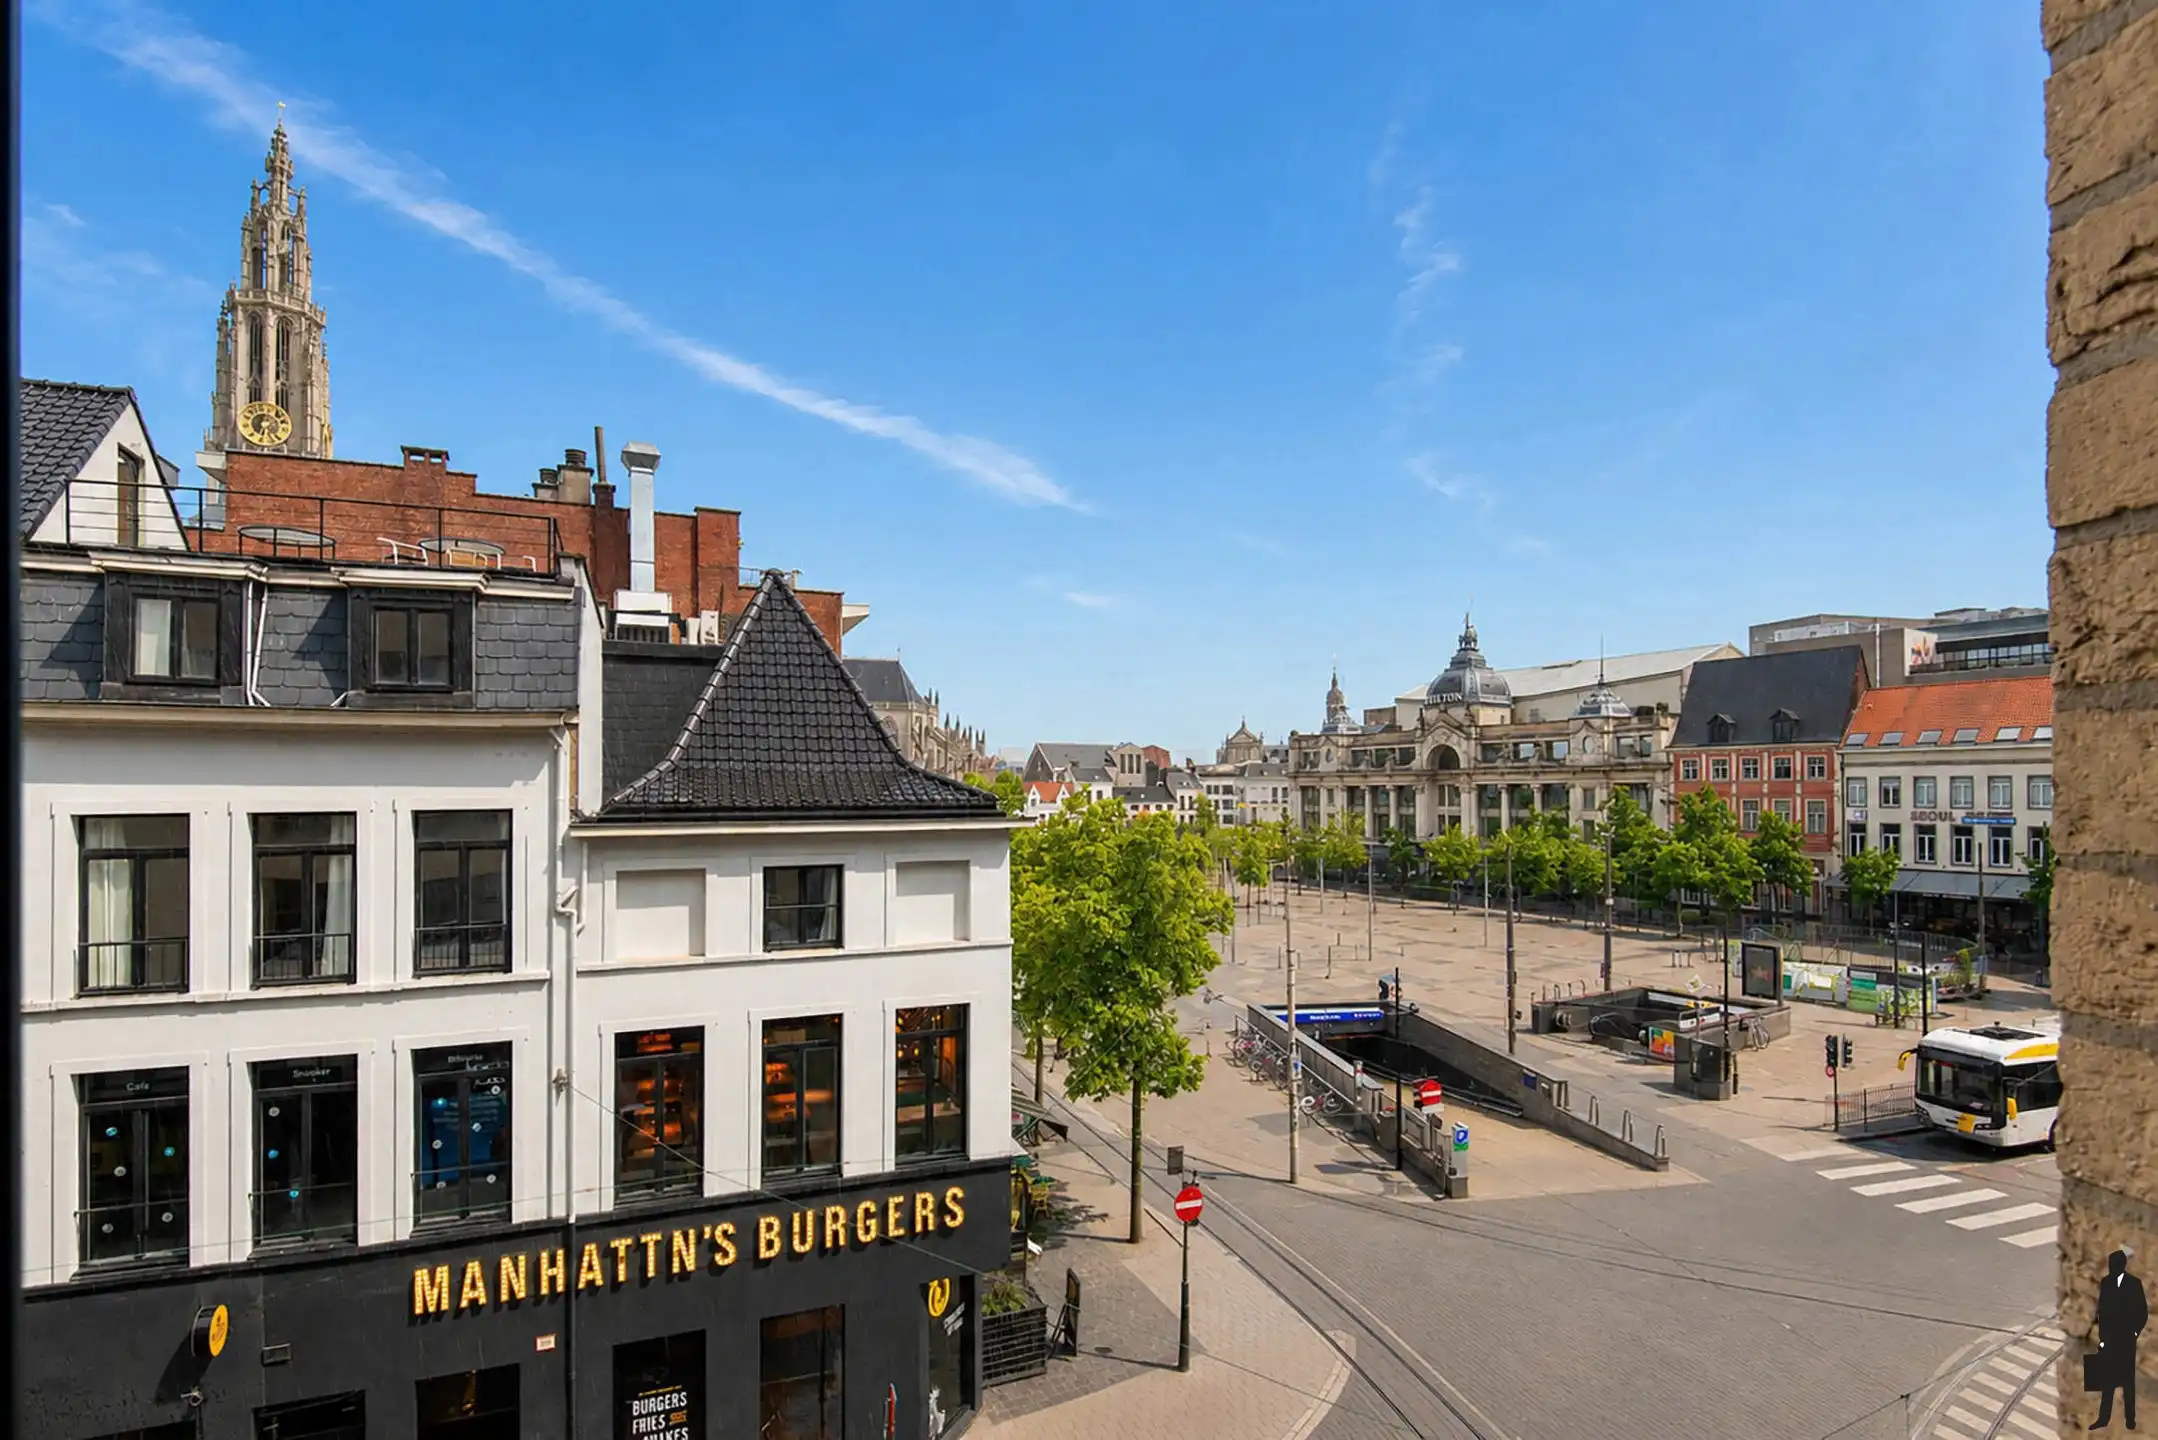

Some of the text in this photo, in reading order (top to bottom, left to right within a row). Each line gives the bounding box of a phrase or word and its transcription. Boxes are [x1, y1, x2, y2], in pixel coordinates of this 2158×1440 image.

[1424, 692, 1462, 704] HILTON
[1910, 811, 1956, 822] SEOUL
[414, 1185, 965, 1315] MANHATTN'S BURGERS
[632, 1391, 688, 1416] BURGERS
[632, 1414, 666, 1435] FRIES
